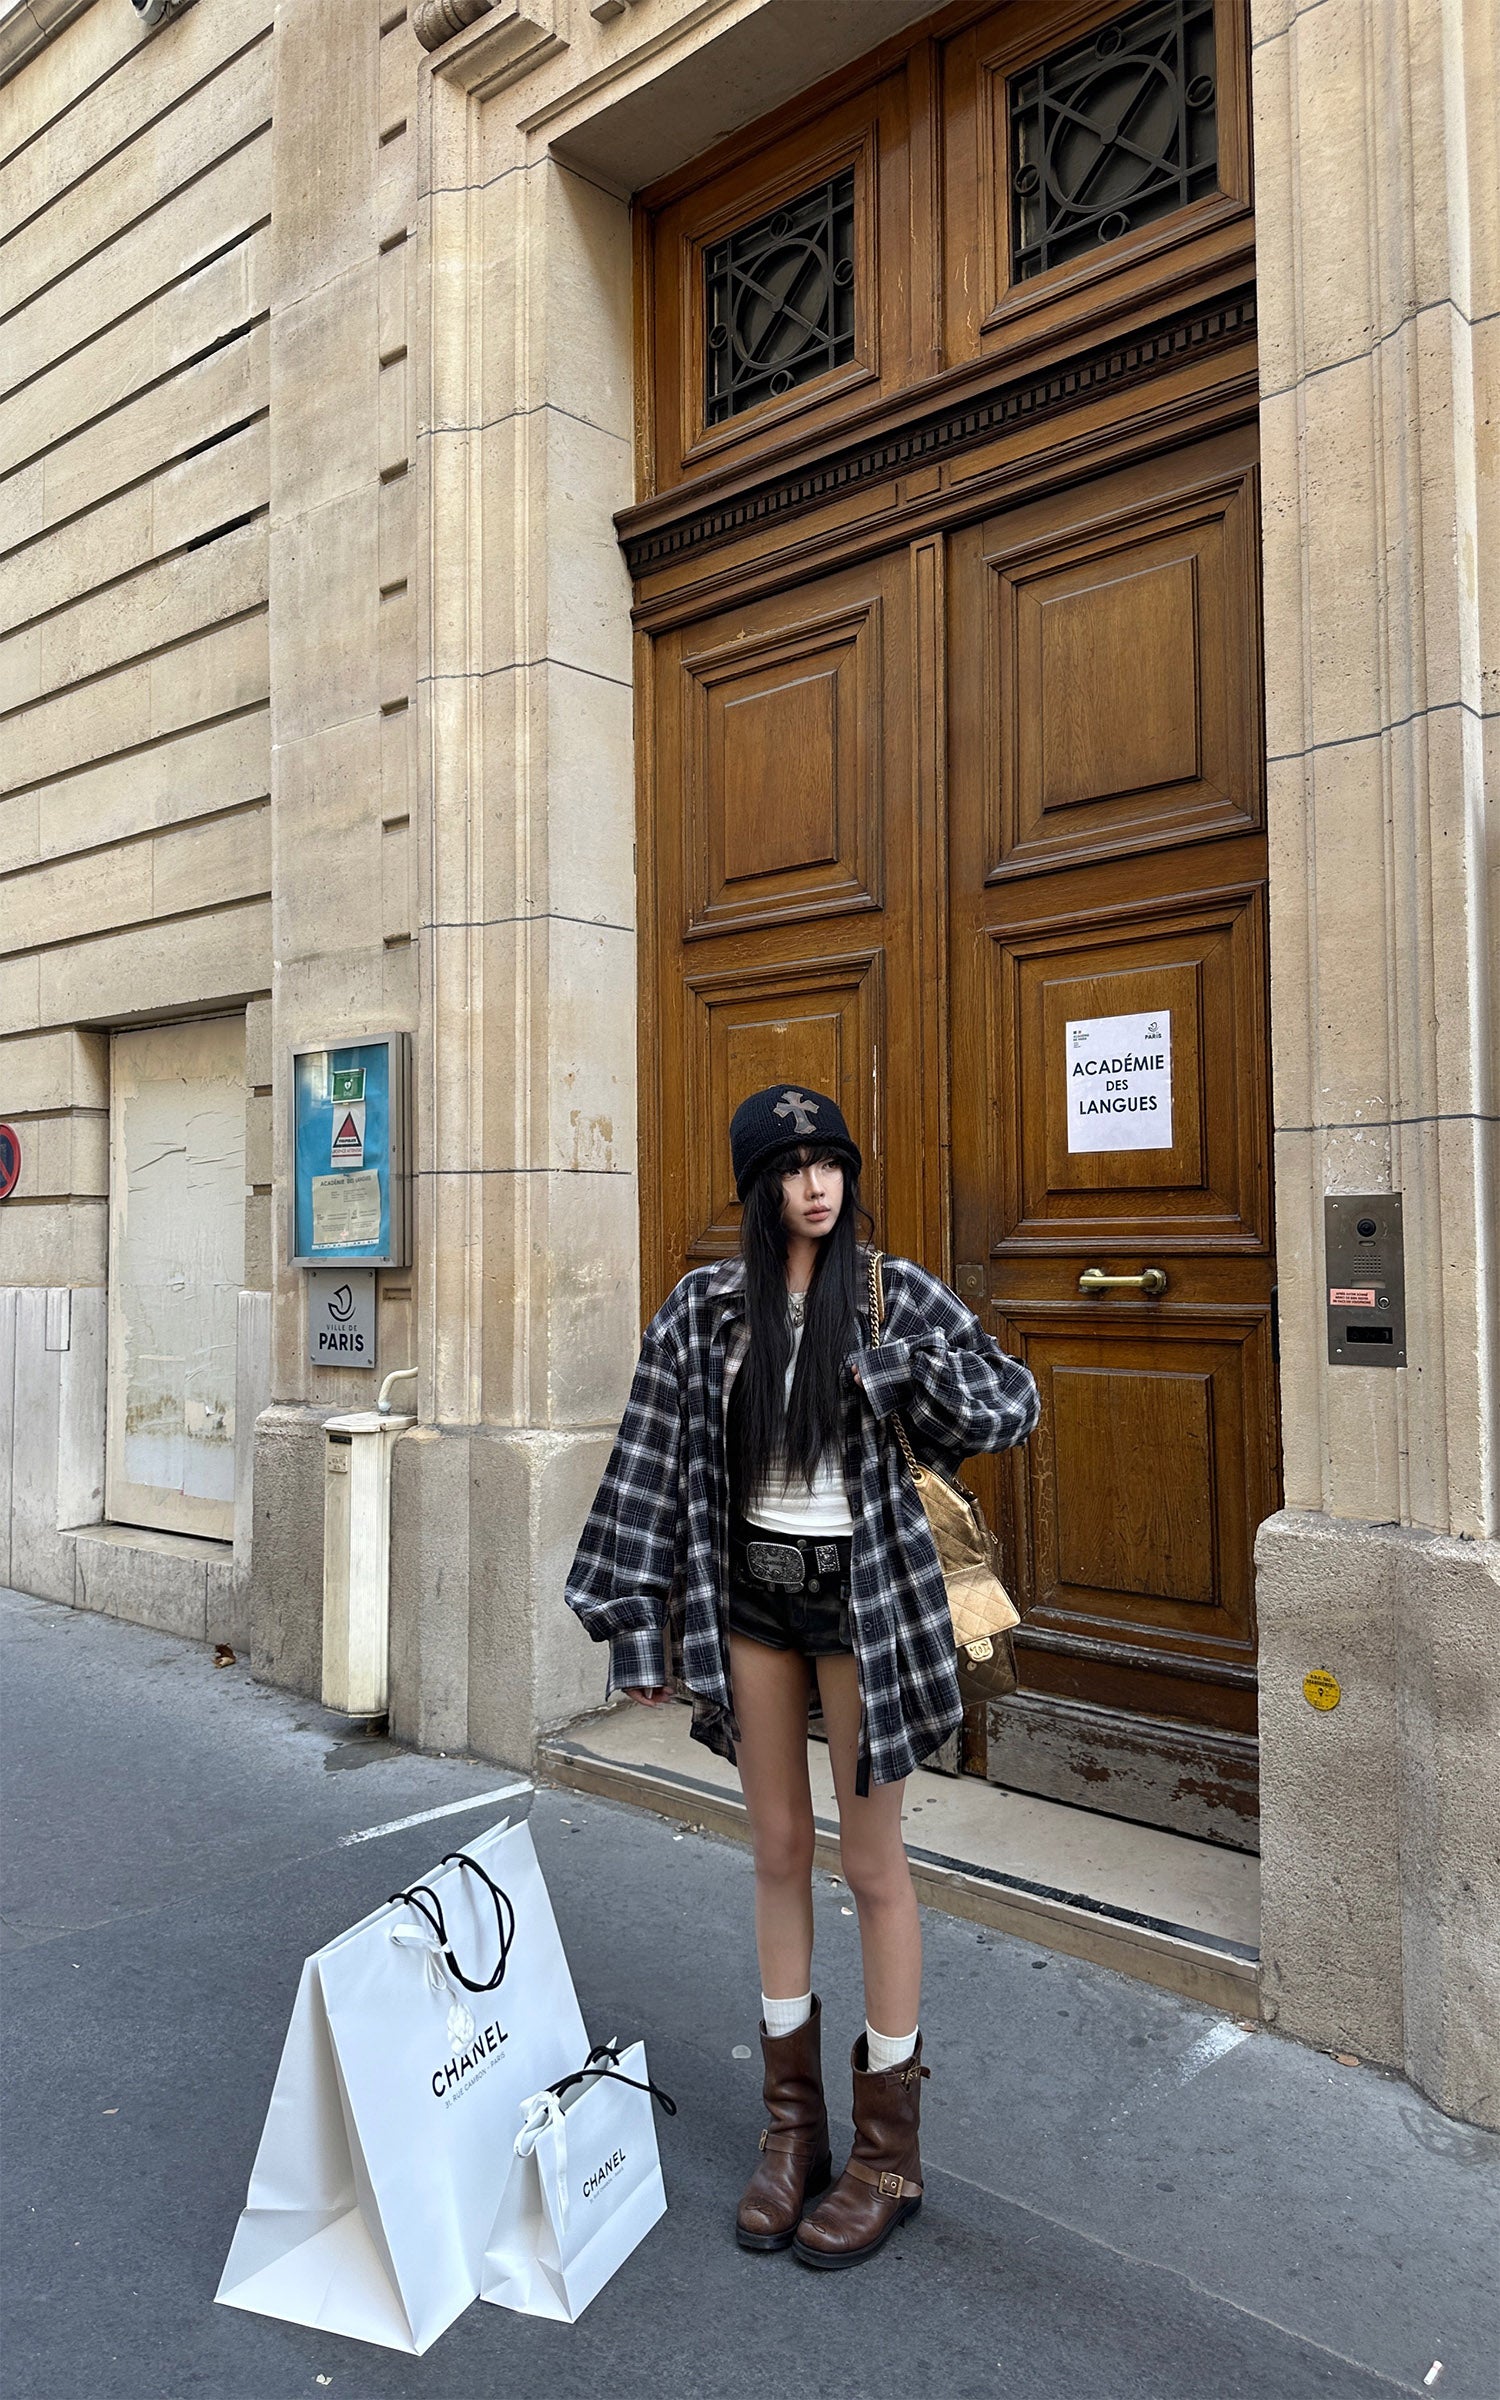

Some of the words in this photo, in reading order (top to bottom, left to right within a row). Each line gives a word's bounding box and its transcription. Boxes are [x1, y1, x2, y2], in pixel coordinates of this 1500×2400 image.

[1072, 1053, 1164, 1077] ACADÉMIE
[1106, 1079, 1129, 1091] DES
[1079, 1095, 1158, 1115] LANGUES
[319, 1333, 364, 1352] PARIS
[432, 2020, 508, 2097] CHANEL
[452, 2088, 464, 2102] RUE
[464, 2069, 487, 2091] CAMBON
[491, 2051, 506, 2067] PARIS
[583, 2148, 626, 2198] CHANEL
